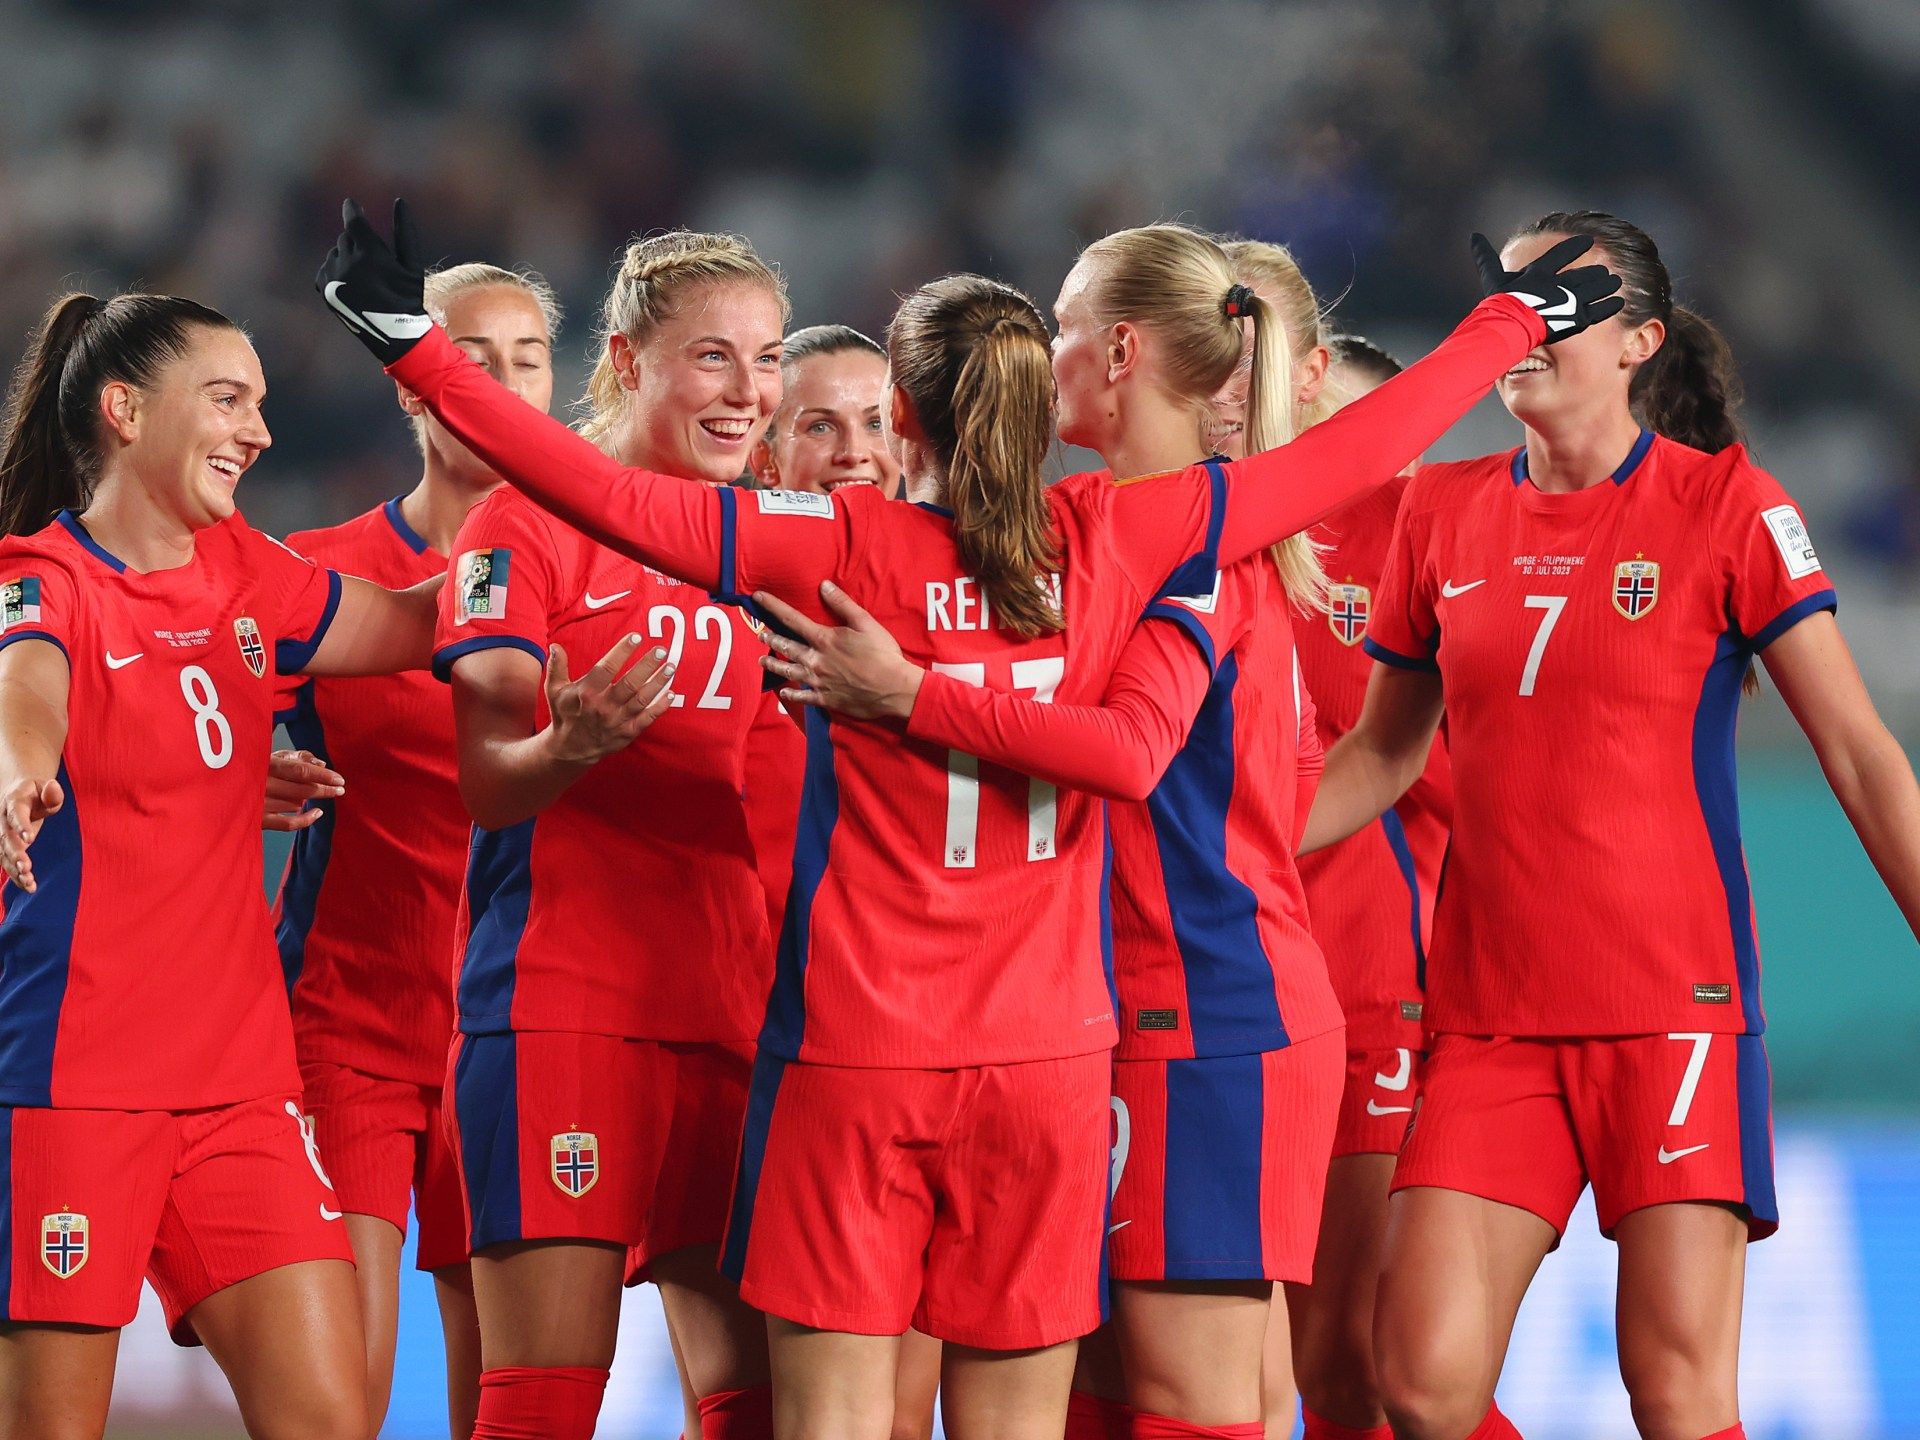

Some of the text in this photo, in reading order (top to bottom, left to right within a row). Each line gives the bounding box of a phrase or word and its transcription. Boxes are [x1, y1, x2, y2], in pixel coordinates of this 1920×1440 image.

[1513, 556, 1537, 566] NORGE
[1522, 566, 1571, 575] 30. JULI 2023
[645, 604, 733, 710] 22
[1518, 595, 1568, 697] 7
[180, 665, 233, 769] 8
[1667, 1032, 1712, 1126] 7
